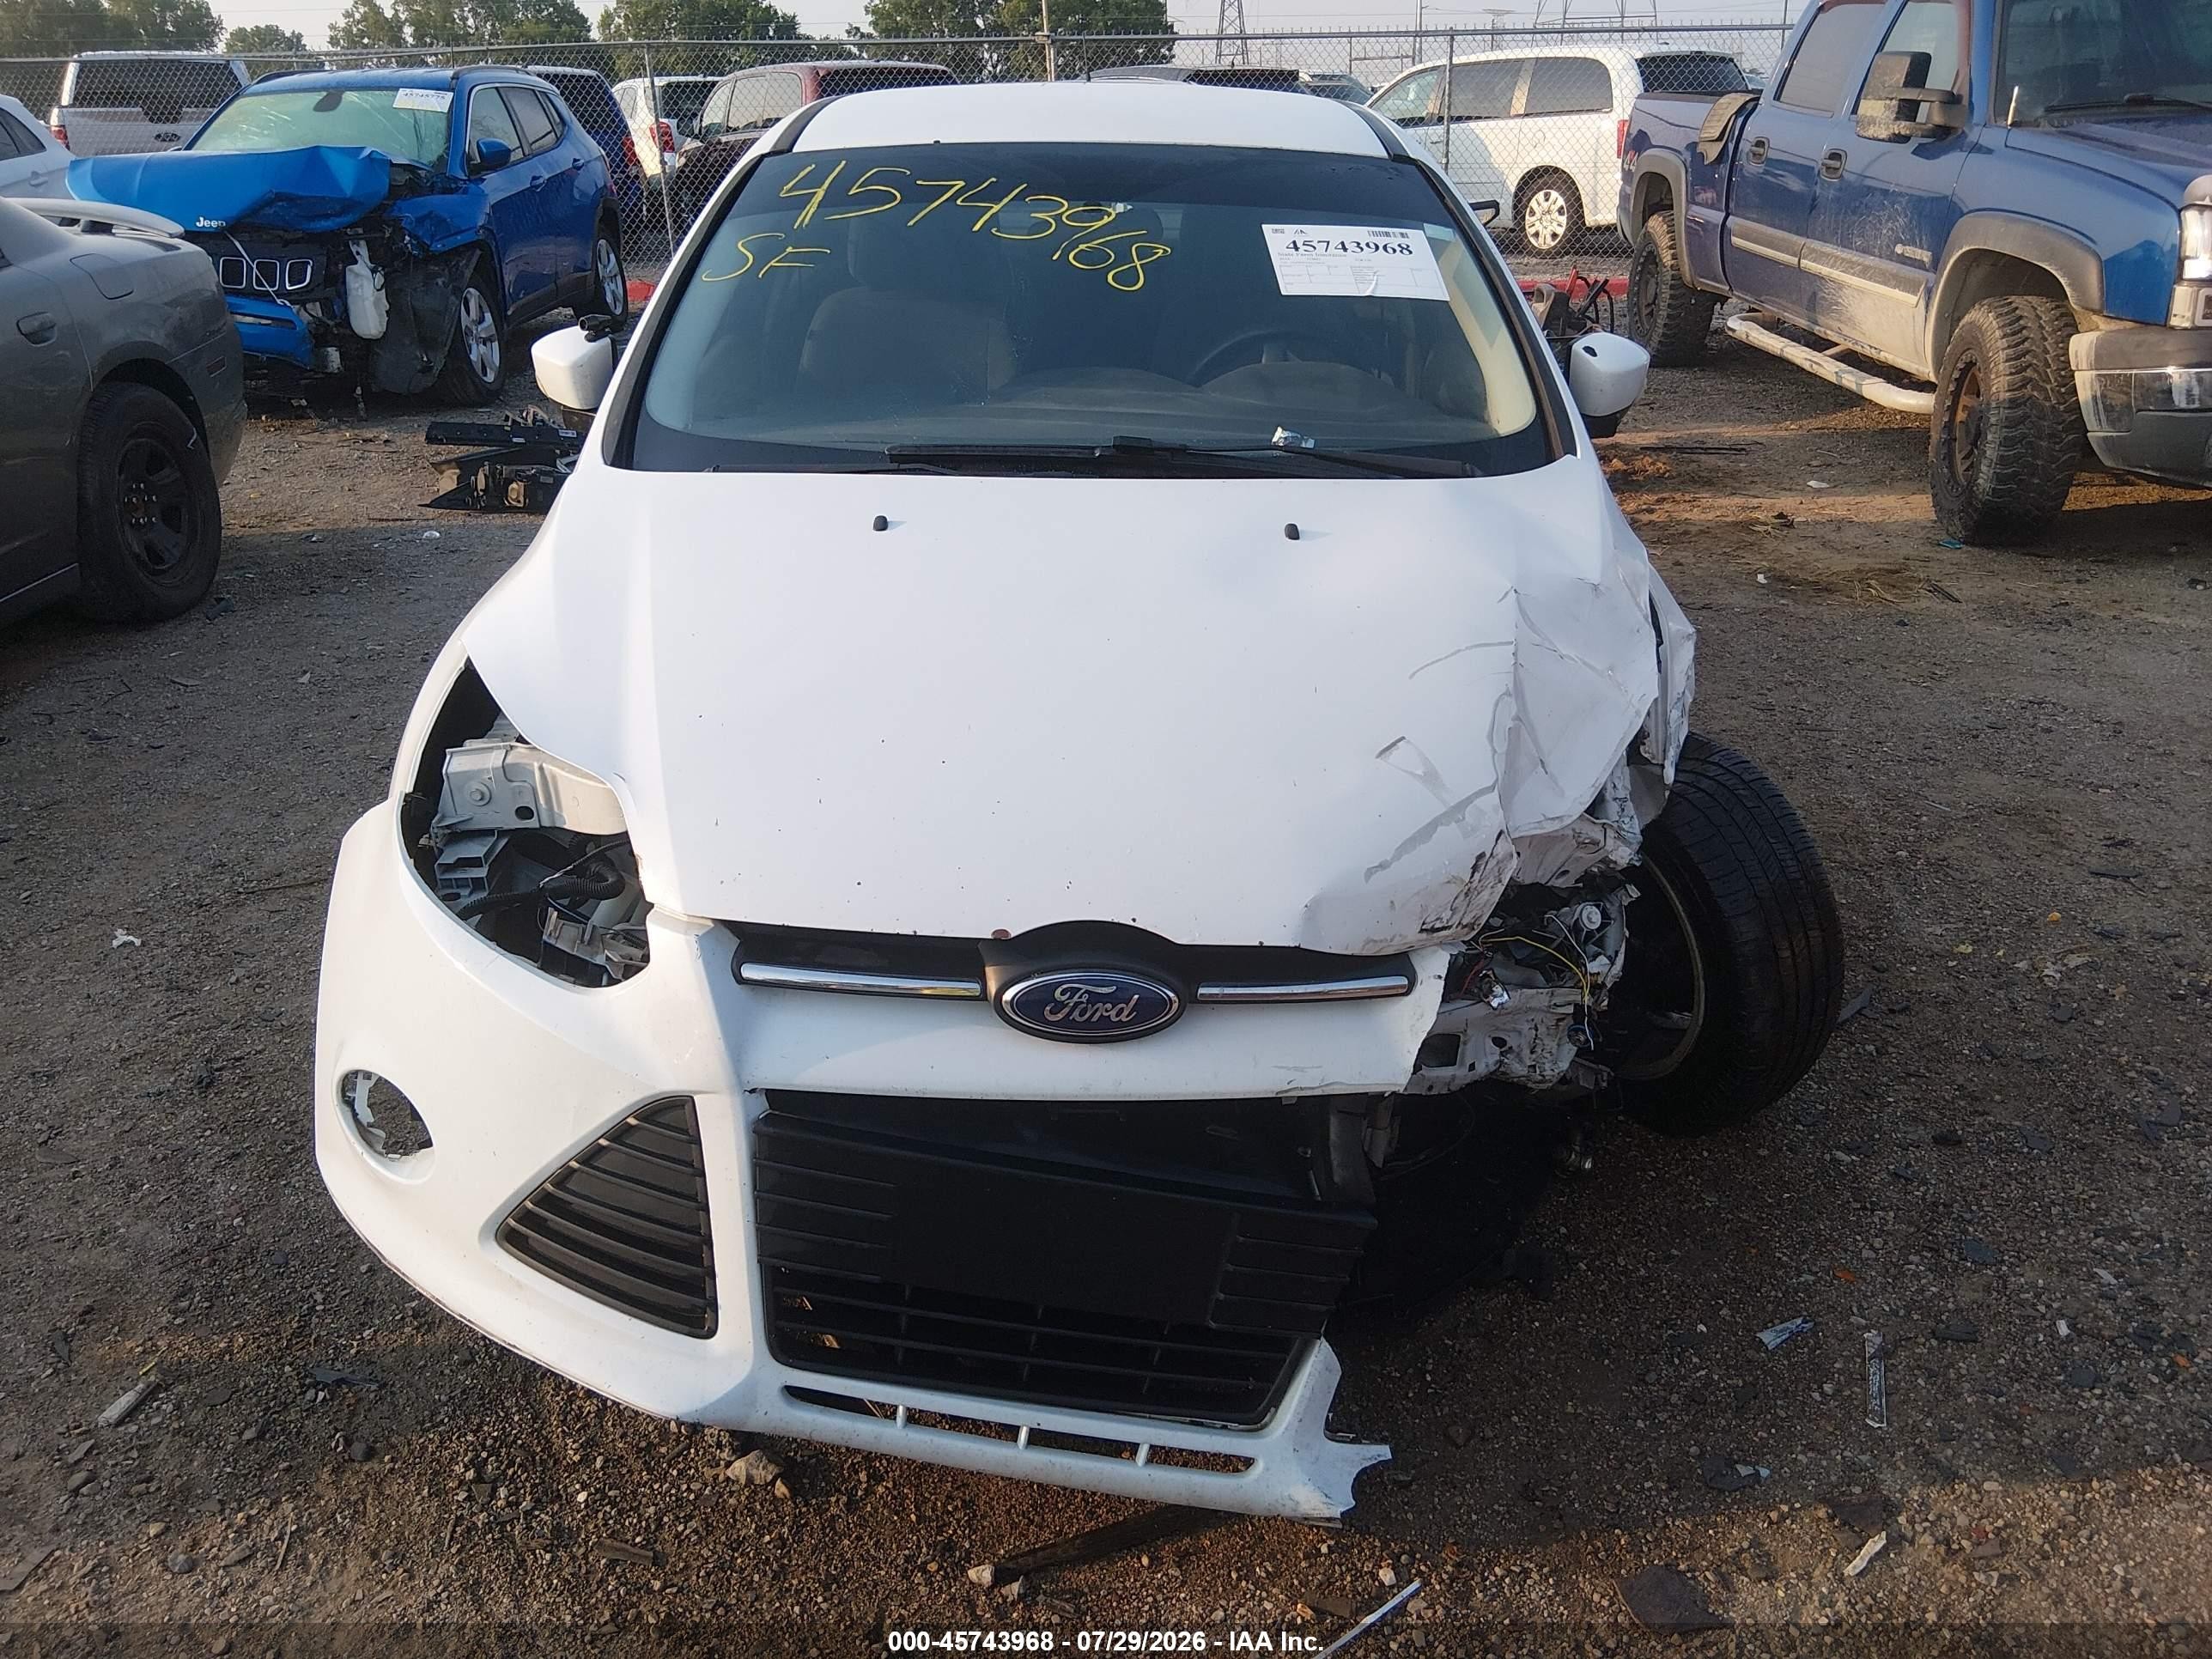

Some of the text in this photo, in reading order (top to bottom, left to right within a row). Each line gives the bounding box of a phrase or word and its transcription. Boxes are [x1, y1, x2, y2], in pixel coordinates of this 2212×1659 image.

[196, 216, 226, 228] Jeep
[702, 233, 831, 283] SF
[1285, 240, 1413, 256] 45743968
[1043, 983, 1139, 1023] Ford
